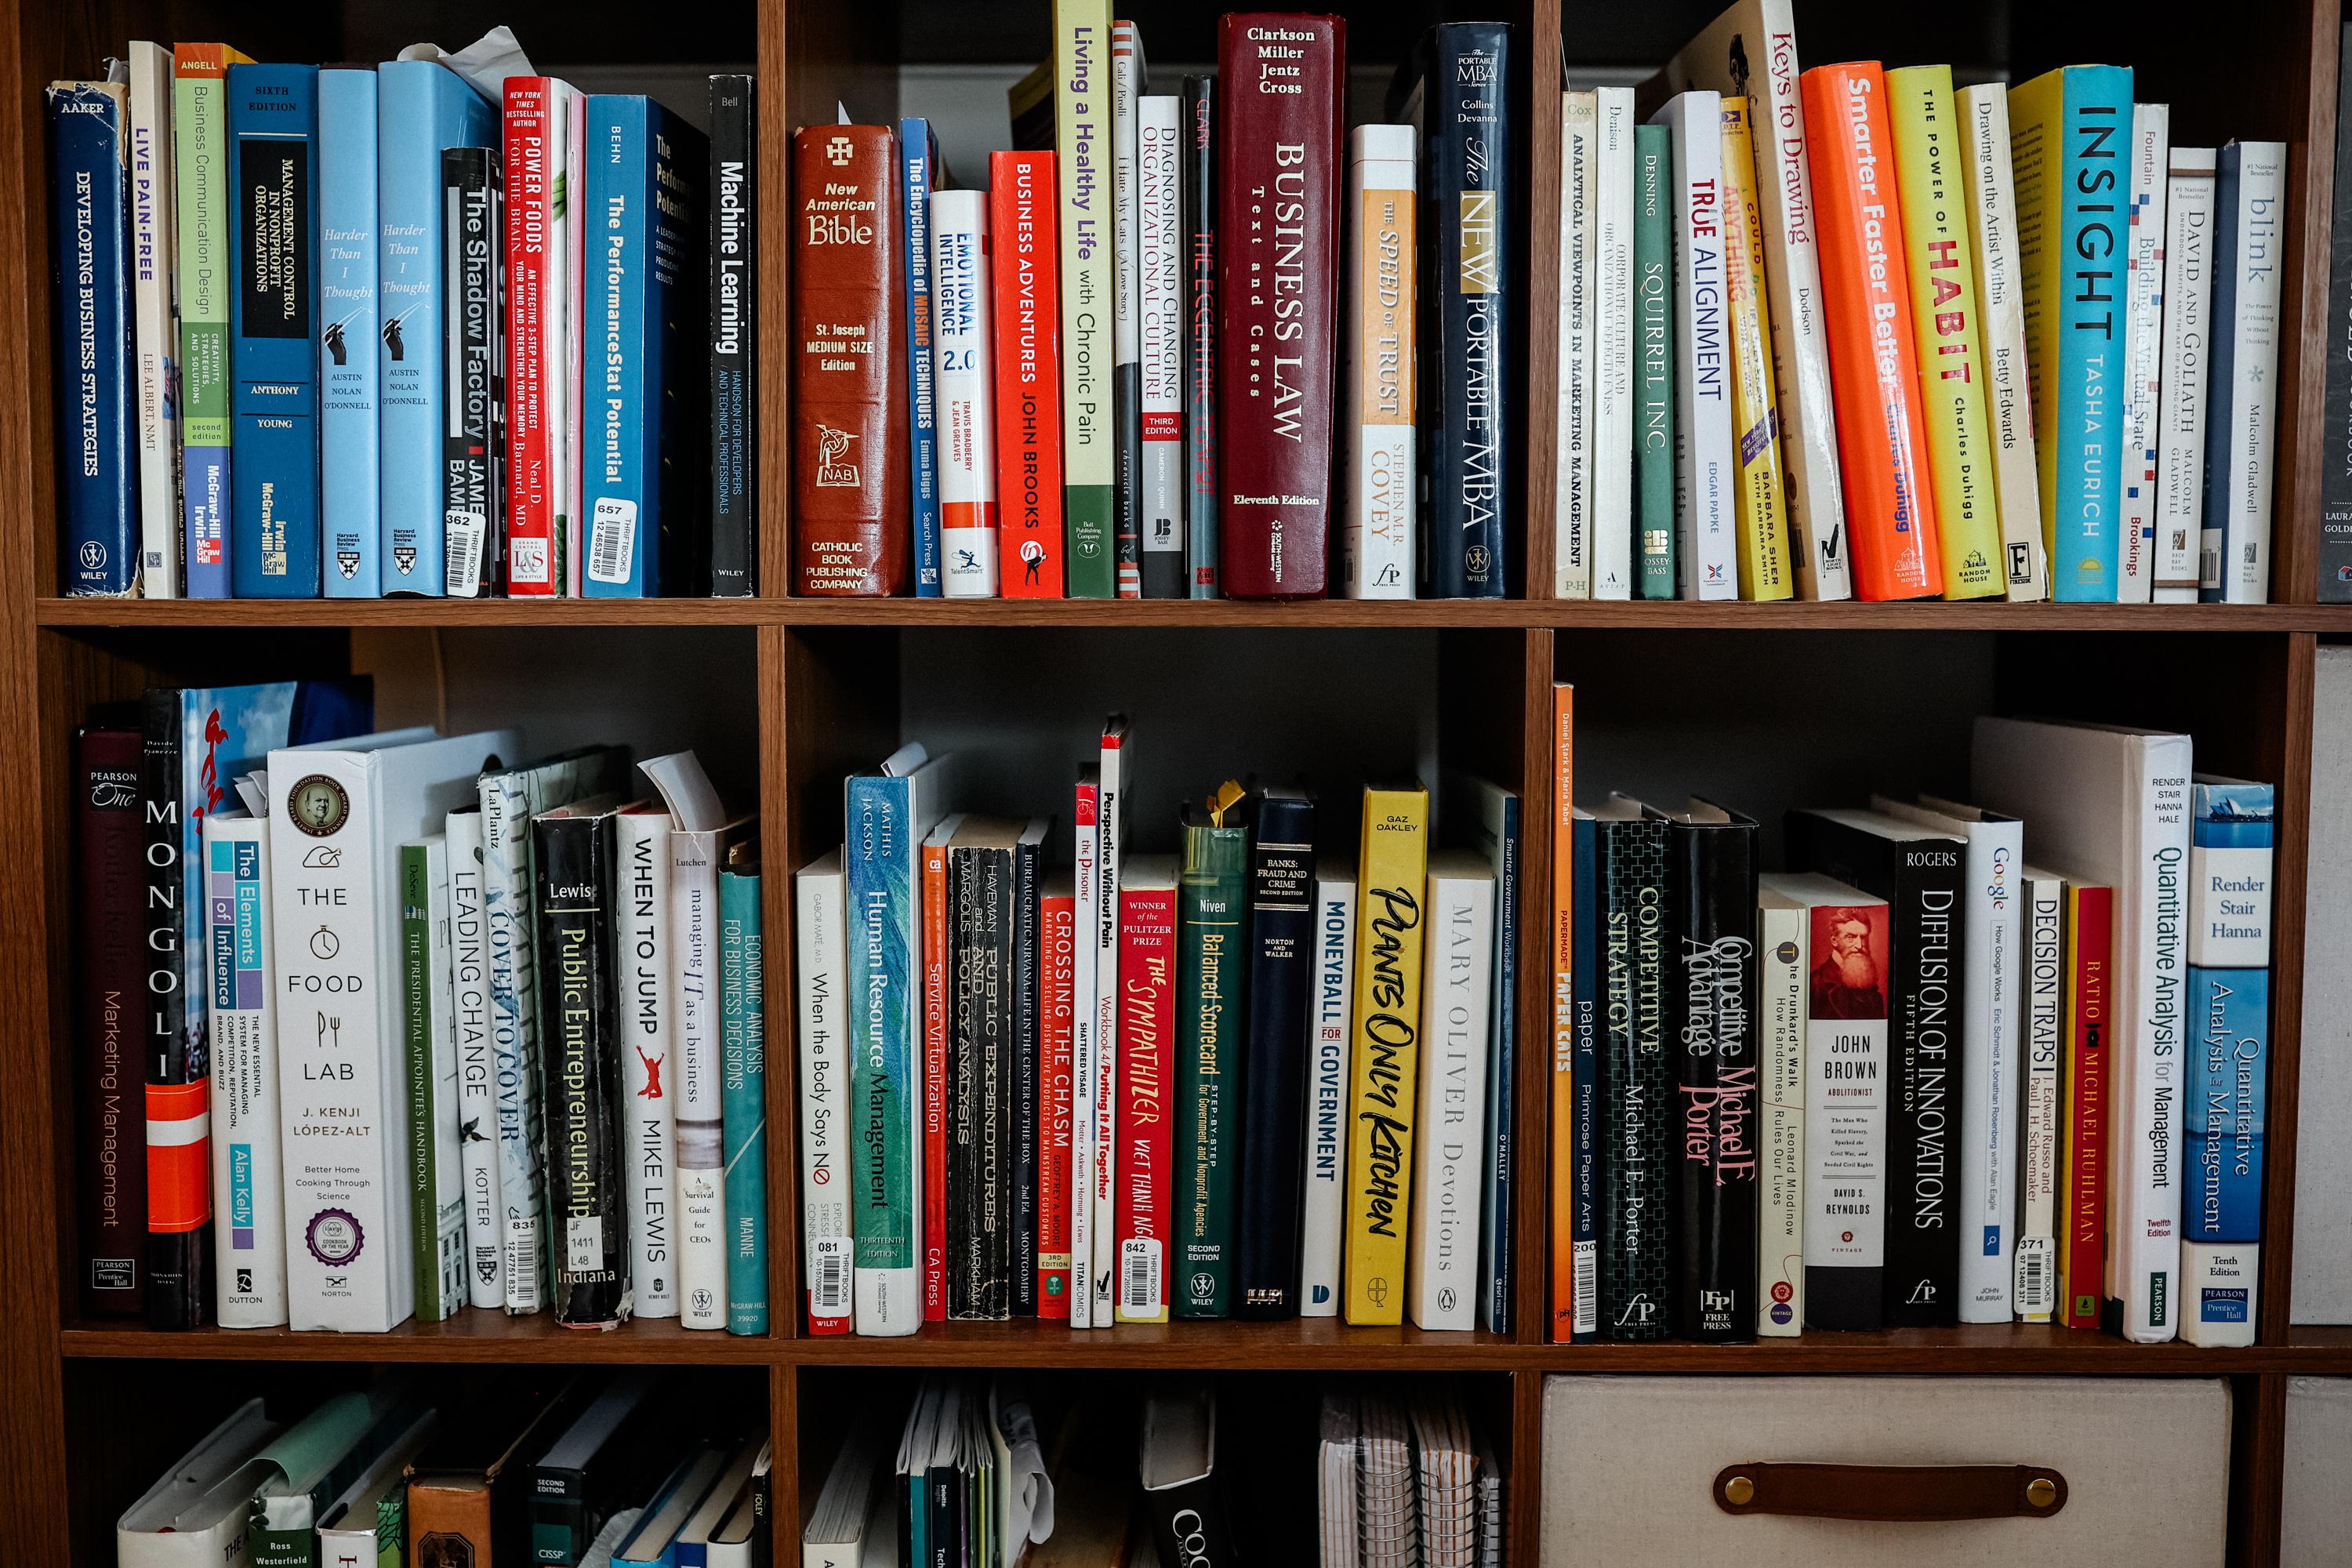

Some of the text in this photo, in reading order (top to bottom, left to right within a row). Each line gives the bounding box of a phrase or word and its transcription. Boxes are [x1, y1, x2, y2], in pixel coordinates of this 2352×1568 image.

[1247, 27, 1315, 41] Clarkson
[1258, 46, 1304, 58] Miller
[181, 61, 217, 70] ANGELL
[1260, 64, 1300, 77] Jentz
[256, 86, 289, 95] SIXTH
[1259, 82, 1301, 94] Cross
[249, 103, 296, 111] EDITION
[722, 97, 738, 107] Bell
[1462, 100, 1494, 109] Collins
[61, 103, 104, 114] AAKER
[1457, 114, 1497, 122] Devanna
[611, 126, 620, 163] BEHN
[825, 183, 858, 196] New
[194, 86, 212, 314] Business Communication Design
[805, 198, 875, 212] American
[2074, 107, 2117, 339] INSIGHT
[325, 229, 368, 241] Harder
[808, 214, 872, 245] Bible
[1849, 78, 1896, 387] Smarter Faster Better
[1923, 90, 1970, 383] THE POWER OF HABIT
[330, 248, 361, 260] Than
[715, 161, 745, 354] Machine Learning
[342, 266, 347, 278] I
[325, 285, 372, 298] Thought
[1273, 142, 1305, 443] BUSINESS LAW
[77, 172, 98, 476] DEVELOPING BUSINESS STRATEGIES
[1017, 163, 1039, 528] BUSINESS ADVENTURES JOHN BROOKS
[251, 386, 299, 395] ANTHONY
[325, 401, 372, 410] O'DONNELL
[257, 419, 292, 429] YOUNG
[2083, 354, 2103, 536] TASHA EURICH
[824, 468, 852, 481] NAB
[1233, 494, 1319, 506] Eleventh Edition
[1371, 451, 1390, 540] COVEY
[597, 504, 622, 514] 657
[812, 543, 862, 552] CATHOLIC
[2126, 517, 2140, 577] Brookings
[822, 555, 852, 564] BOOK
[807, 567, 867, 577] PUBLISHING
[811, 579, 862, 590] COMPANY
[91, 772, 137, 782] PEARSON
[1377, 823, 1417, 832] OAKLEY
[1268, 859, 1298, 868] BANKS:
[1907, 852, 1957, 867] ROGERS
[1258, 869, 1307, 879] FRAUD AND
[1269, 880, 1295, 888] CRIME
[2212, 877, 2264, 891] Render
[298, 888, 347, 906] THE
[550, 884, 591, 898] Lewis
[239, 845, 255, 964] The Elements
[1200, 899, 1225, 913] Niven
[2220, 901, 2255, 915] Stair
[1124, 925, 1172, 934] PULITZER
[2212, 923, 2261, 938] Hanna
[216, 902, 230, 1006] of Influence
[289, 976, 362, 993] FOOD
[1316, 902, 1345, 1181] MONEYBALL FOR GOVERNMENT
[1831, 1035, 1870, 1053] JOHN
[864, 891, 888, 1208] Human Resource Management
[305, 1063, 354, 1080] LAB
[561, 928, 591, 1218] Public Entrepreneurship
[1825, 1062, 1877, 1079] BROWN
[303, 1108, 360, 1117] J. KENJI
[294, 1125, 370, 1137] LÓPEZ-ALT
[235, 1150, 250, 1224] Alan Kelly
[296, 1179, 370, 1189] Cooking Through
[474, 1168, 490, 1226] KOTTER
[1834, 1189, 1866, 1198] DAVID S.
[1826, 1204, 1870, 1214] REYNOLDS
[572, 1239, 593, 1247] 1411
[818, 1243, 837, 1253] 081
[1126, 1243, 1145, 1253] 842
[2020, 1240, 2044, 1249] 371
[2213, 1256, 2238, 1265] Tenth
[557, 1269, 615, 1284] Indiana
[256, 1556, 307, 1565] Westerfield
